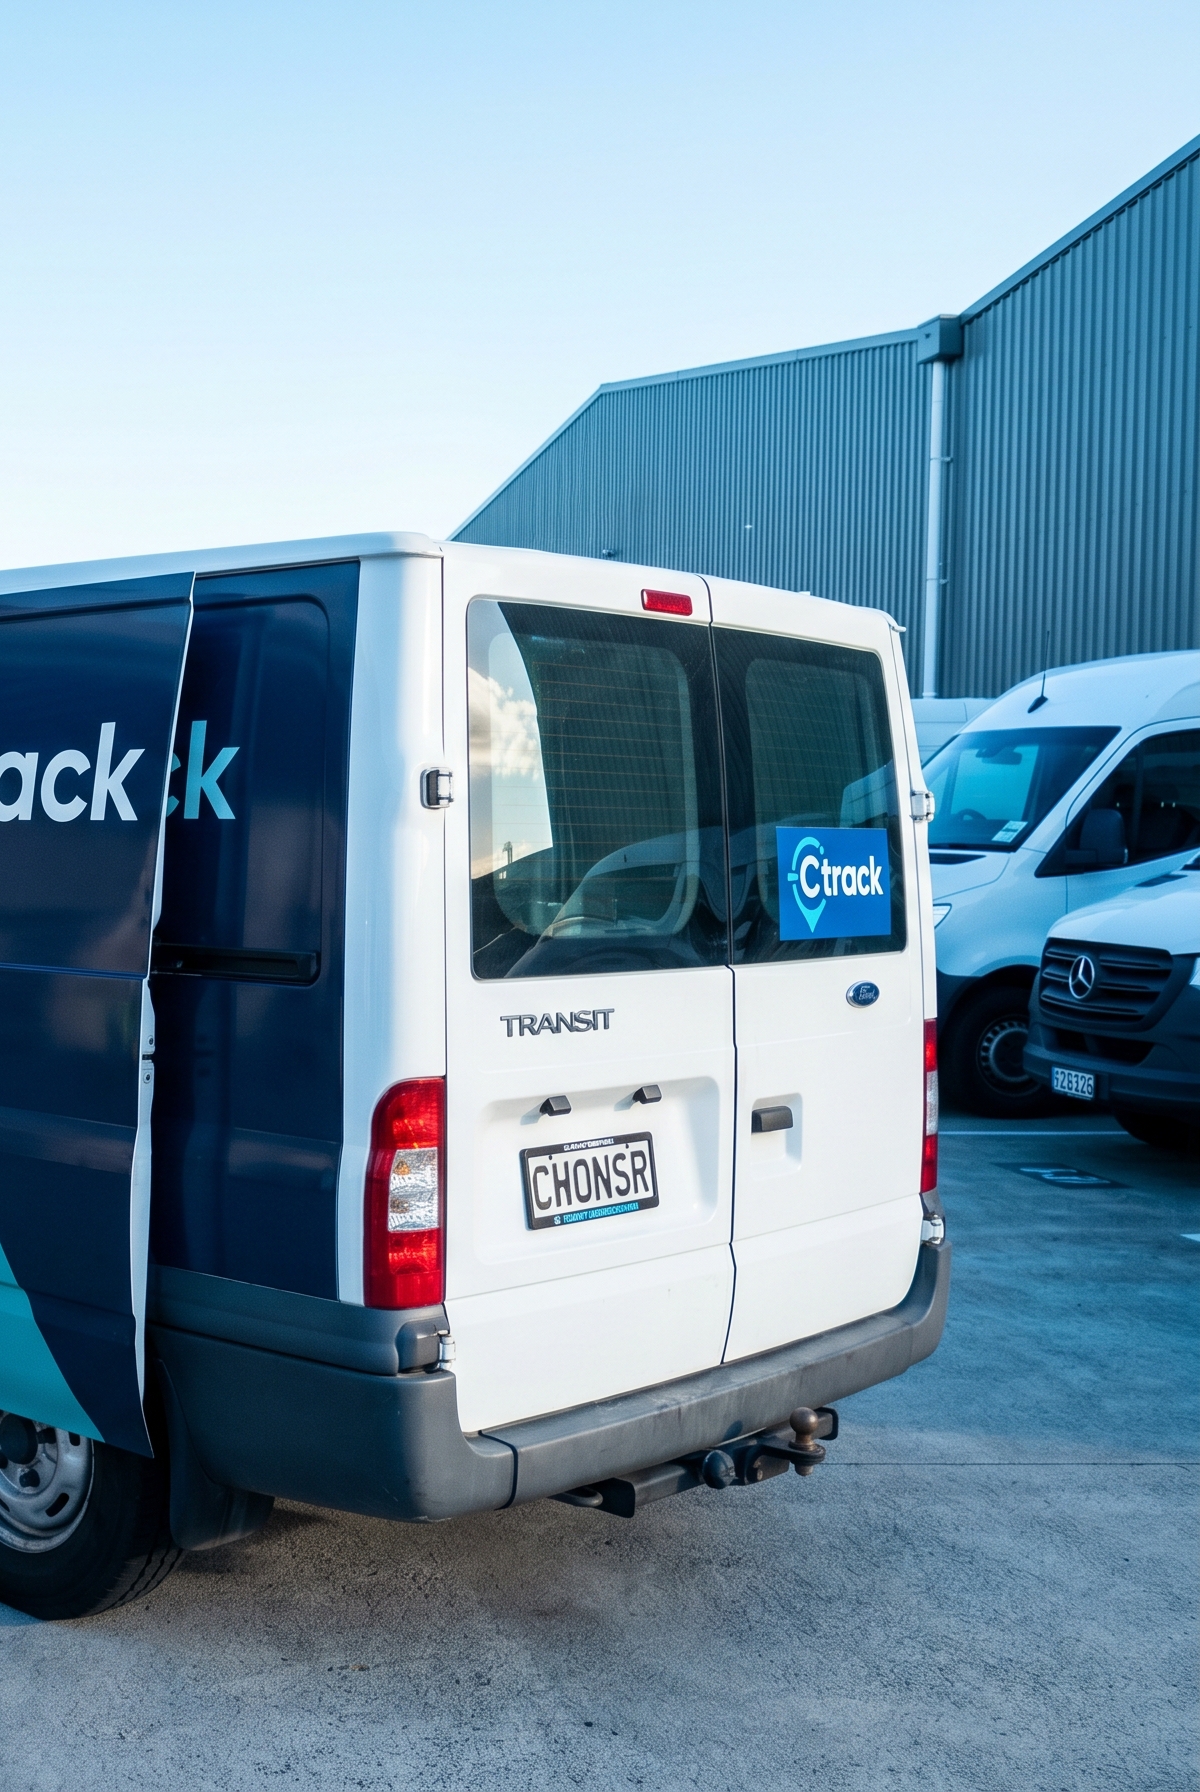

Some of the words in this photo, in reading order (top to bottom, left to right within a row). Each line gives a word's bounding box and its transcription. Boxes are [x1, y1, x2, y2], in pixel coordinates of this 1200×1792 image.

[799, 854, 884, 899] Ctrack
[499, 1008, 615, 1038] TRANSIT
[532, 1149, 650, 1211] CHONSR
